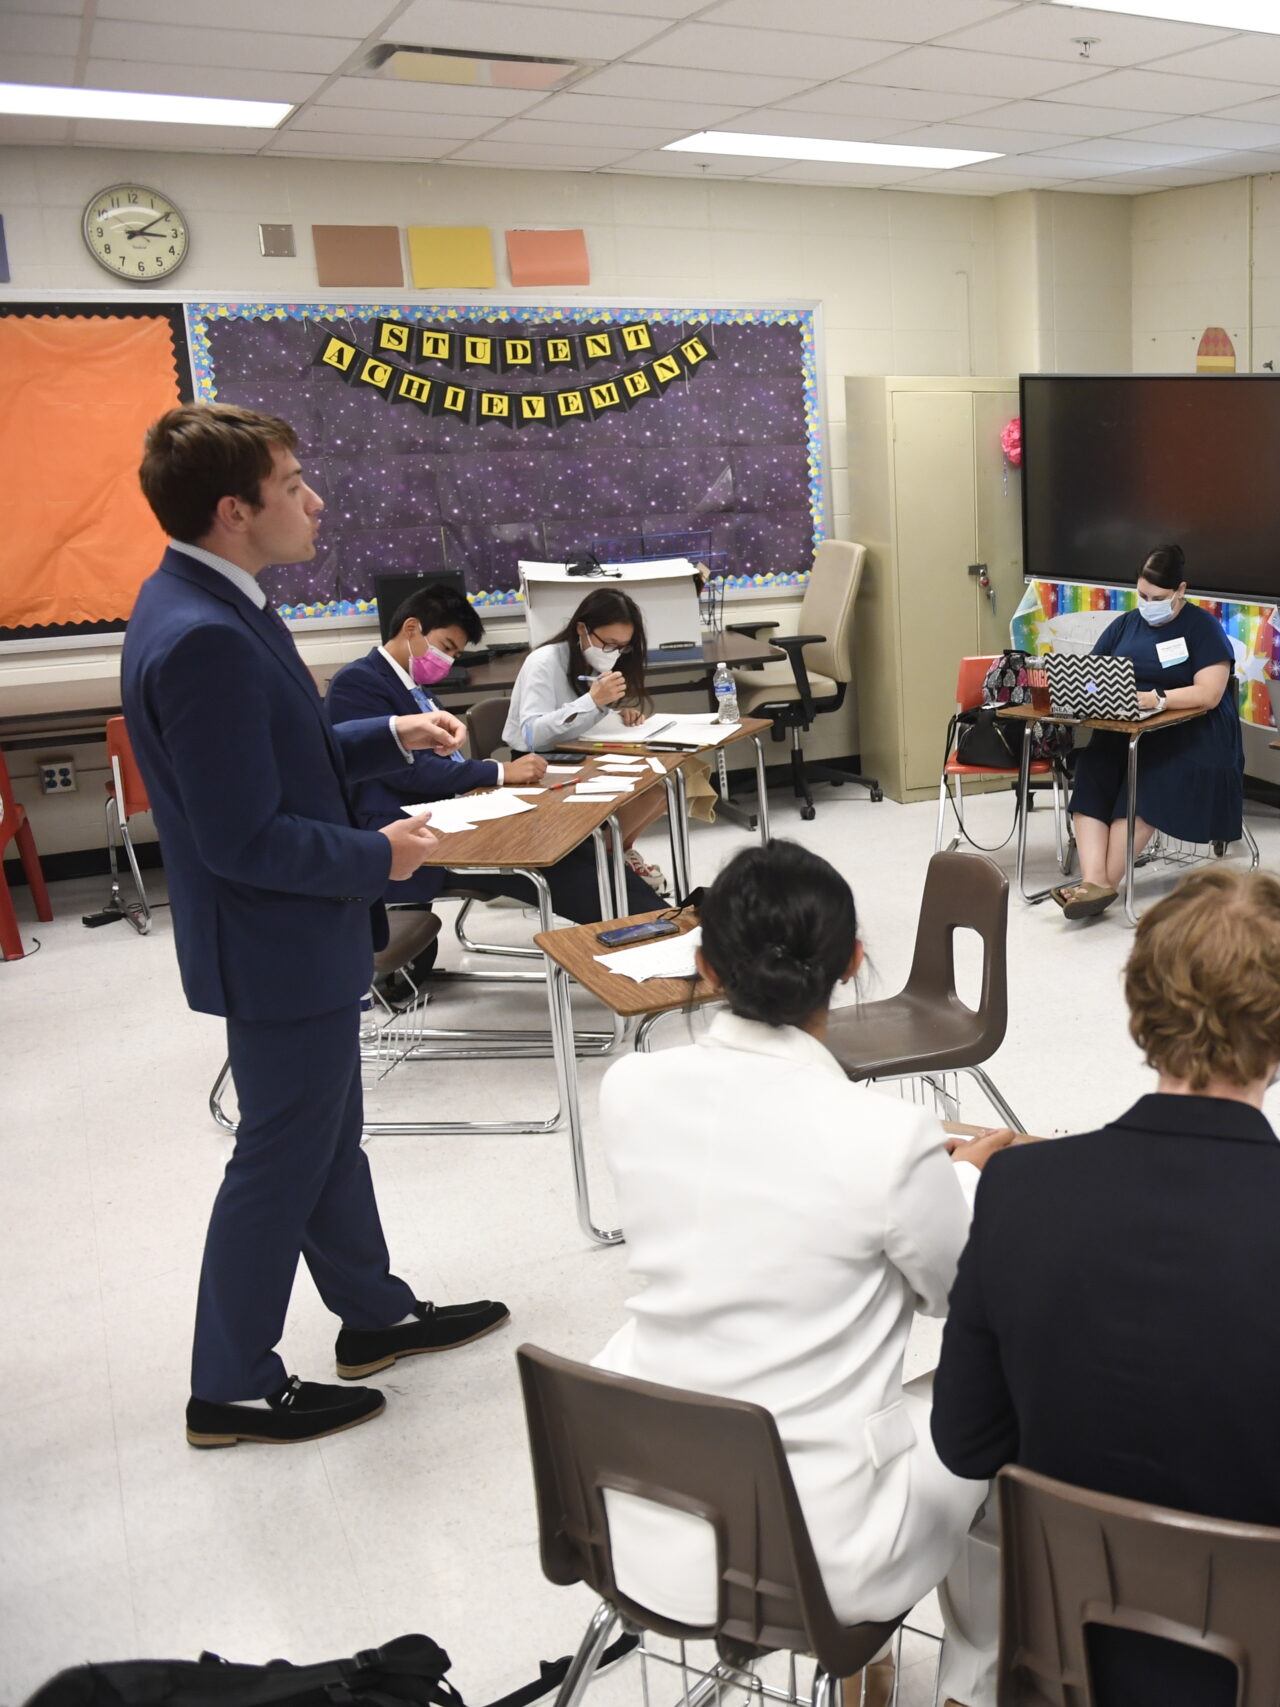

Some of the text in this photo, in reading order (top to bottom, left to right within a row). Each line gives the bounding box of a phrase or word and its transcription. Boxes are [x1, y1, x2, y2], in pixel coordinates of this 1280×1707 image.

[111, 197, 120, 208] 11
[127, 193, 139, 204] 12
[96, 227, 104, 238] 9
[171, 229, 178, 239] 3
[104, 244, 111, 254] 8
[168, 245, 175, 256] 4
[119, 256, 126, 267] 7
[137, 261, 145, 272] 6
[156, 257, 163, 267] 5
[387, 327, 646, 361] STUDENT
[328, 340, 703, 417] ACHIEVEMENT
